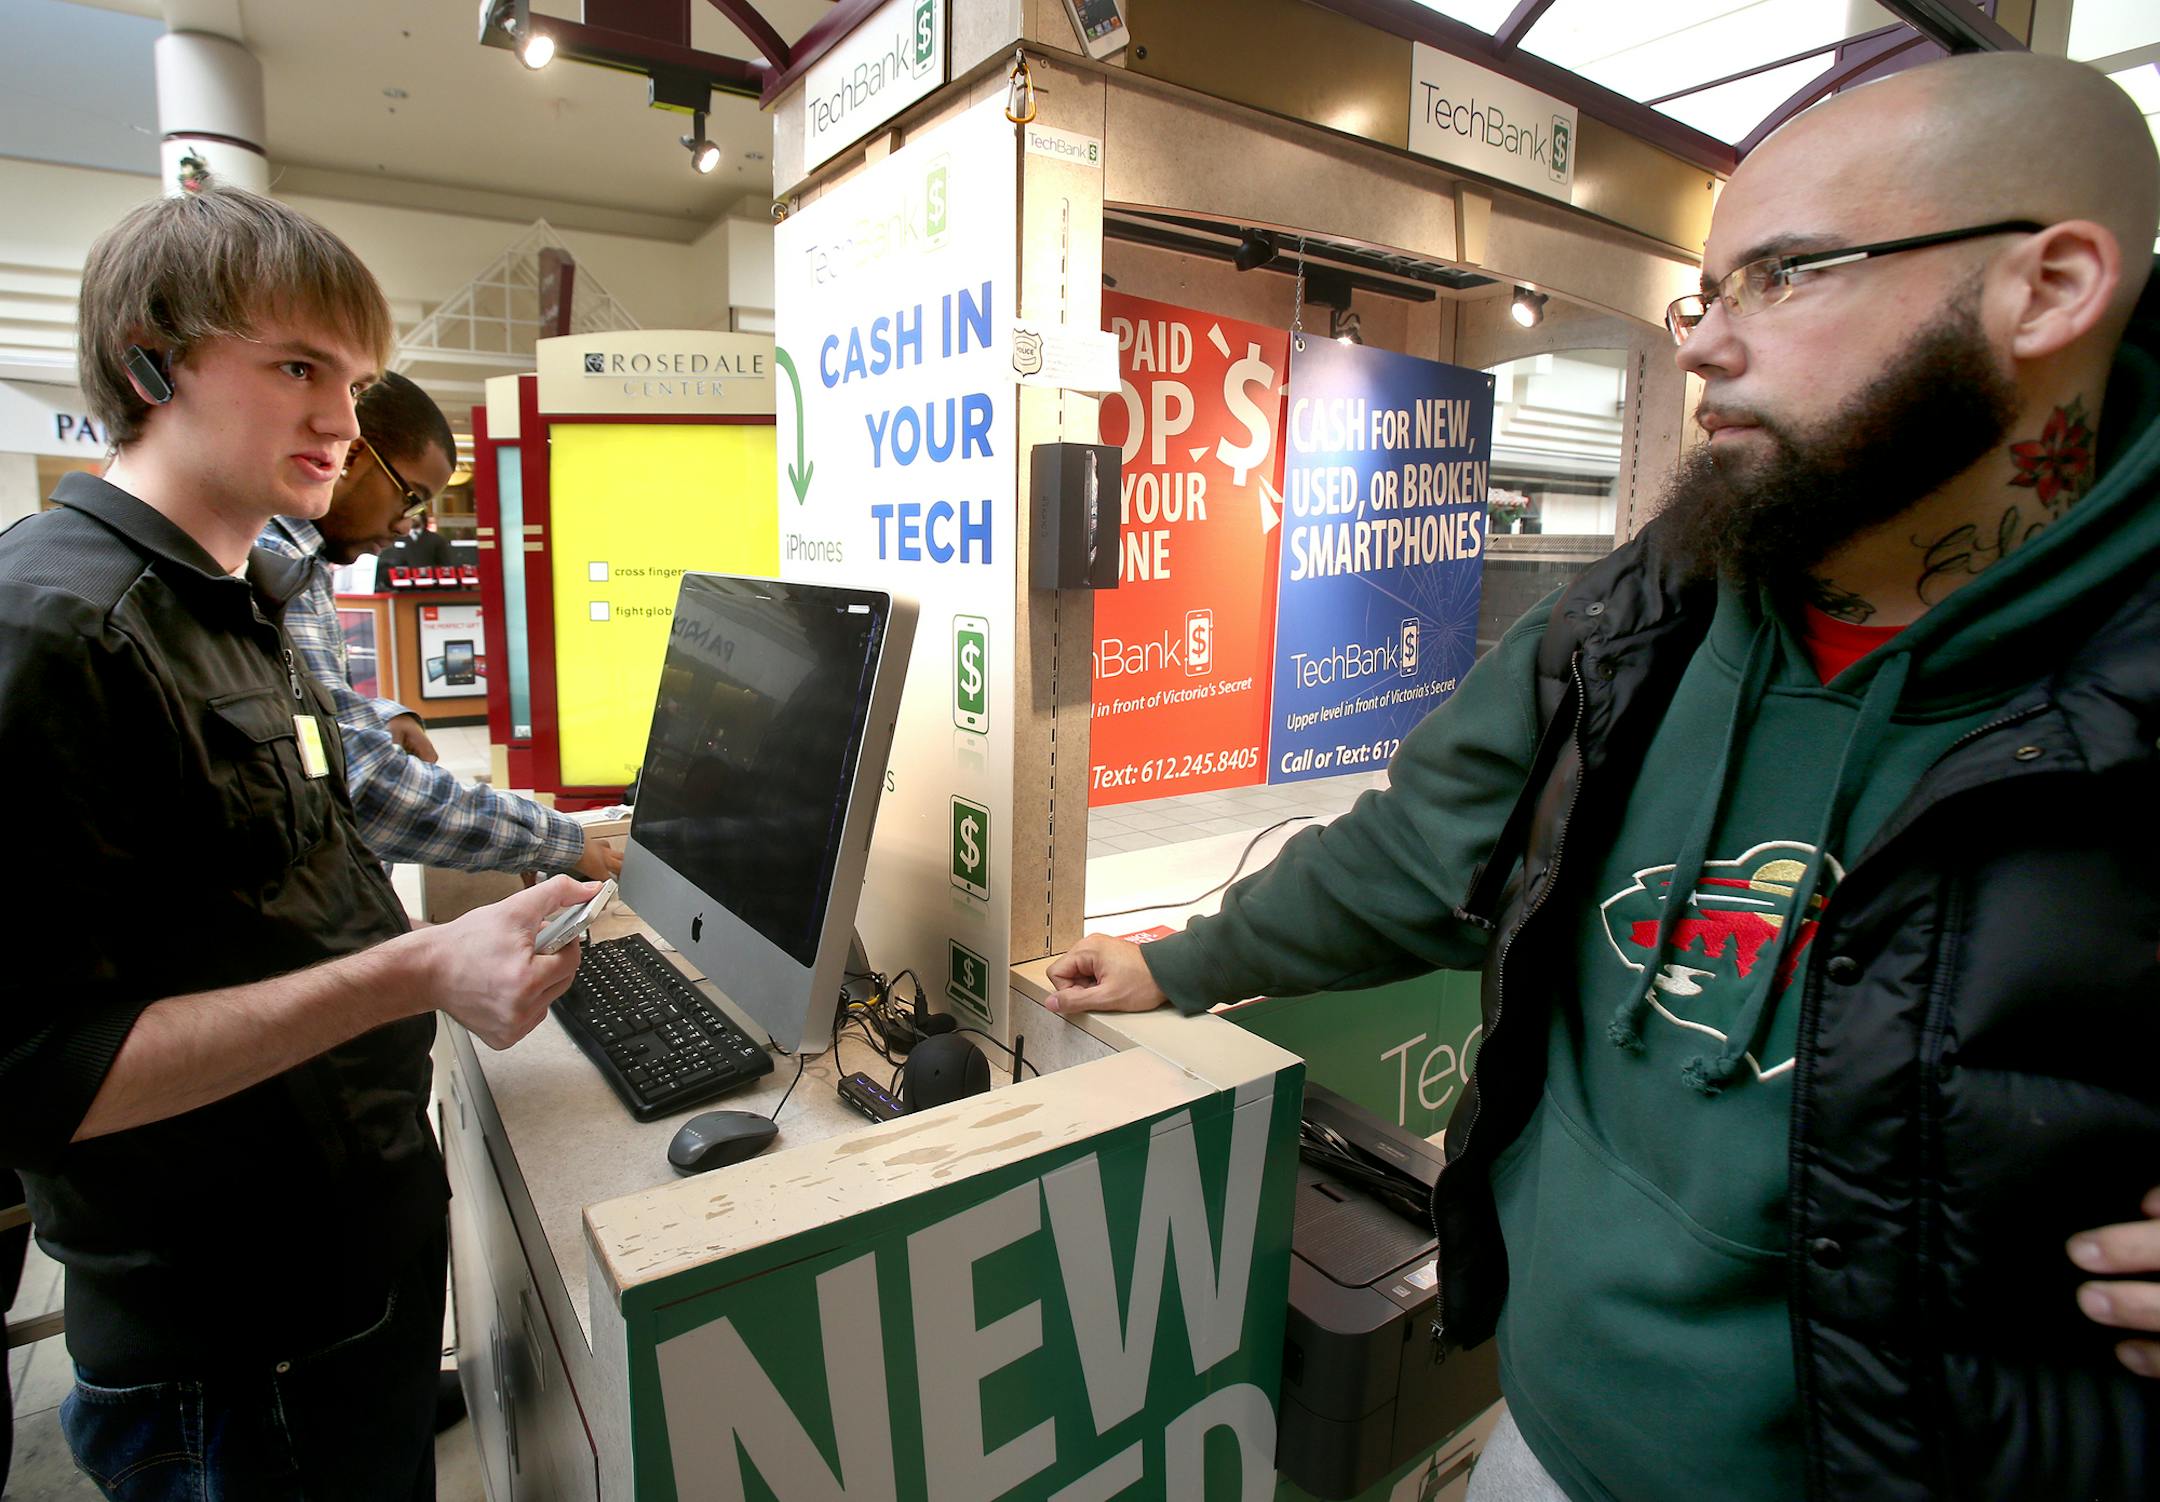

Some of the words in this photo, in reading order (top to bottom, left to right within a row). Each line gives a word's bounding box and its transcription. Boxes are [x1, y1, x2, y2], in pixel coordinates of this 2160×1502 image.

[809, 34, 909, 137] TechBank
[1028, 132, 1087, 158] TechBank
[1420, 81, 1547, 165] TechBank
[820, 304, 922, 388] CASH
[942, 281, 992, 358] IN
[1112, 316, 1193, 374] PAID
[612, 354, 763, 374] ROSEDALE
[624, 381, 725, 397] CENTER
[57, 413, 107, 442] PA
[865, 393, 994, 468] YOUR
[1098, 378, 1195, 465] OP
[1292, 398, 1365, 453] CASH
[1371, 409, 1410, 450] FOR
[1415, 399, 1475, 454] NEW,
[1120, 472, 1207, 525] YOUR
[1291, 466, 1366, 520] USED,
[1370, 470, 1399, 512] OR
[1403, 461, 1487, 509] BROKEN
[786, 534, 843, 563] iPhones
[871, 500, 992, 564] TECH
[1119, 530, 1171, 582] NE
[1290, 511, 1481, 581] SMARTPHONES
[615, 568, 645, 576] cross
[616, 607, 643, 617] fight
[646, 607, 672, 617] glob
[1290, 636, 1399, 689] TechBank
[1097, 702, 1110, 717] in
[1113, 698, 1145, 715] front
[1147, 691, 1162, 709] of
[1163, 683, 1216, 705] Victoria's
[1218, 677, 1252, 694] Secret
[1287, 710, 1322, 732] Upper
[1321, 701, 1343, 722] level
[1344, 700, 1354, 716] in
[1355, 697, 1378, 714] front
[1380, 690, 1391, 707] of
[1391, 682, 1430, 704] Victoria's
[1431, 677, 1456, 695] Secret
[1092, 764, 1138, 789] Text:
[1141, 747, 1259, 783] 612.245.8405
[1281, 748, 1313, 774] Call
[1314, 750, 1332, 769] or
[1335, 744, 1370, 765] Text:
[655, 1071, 1274, 1502] NEW
